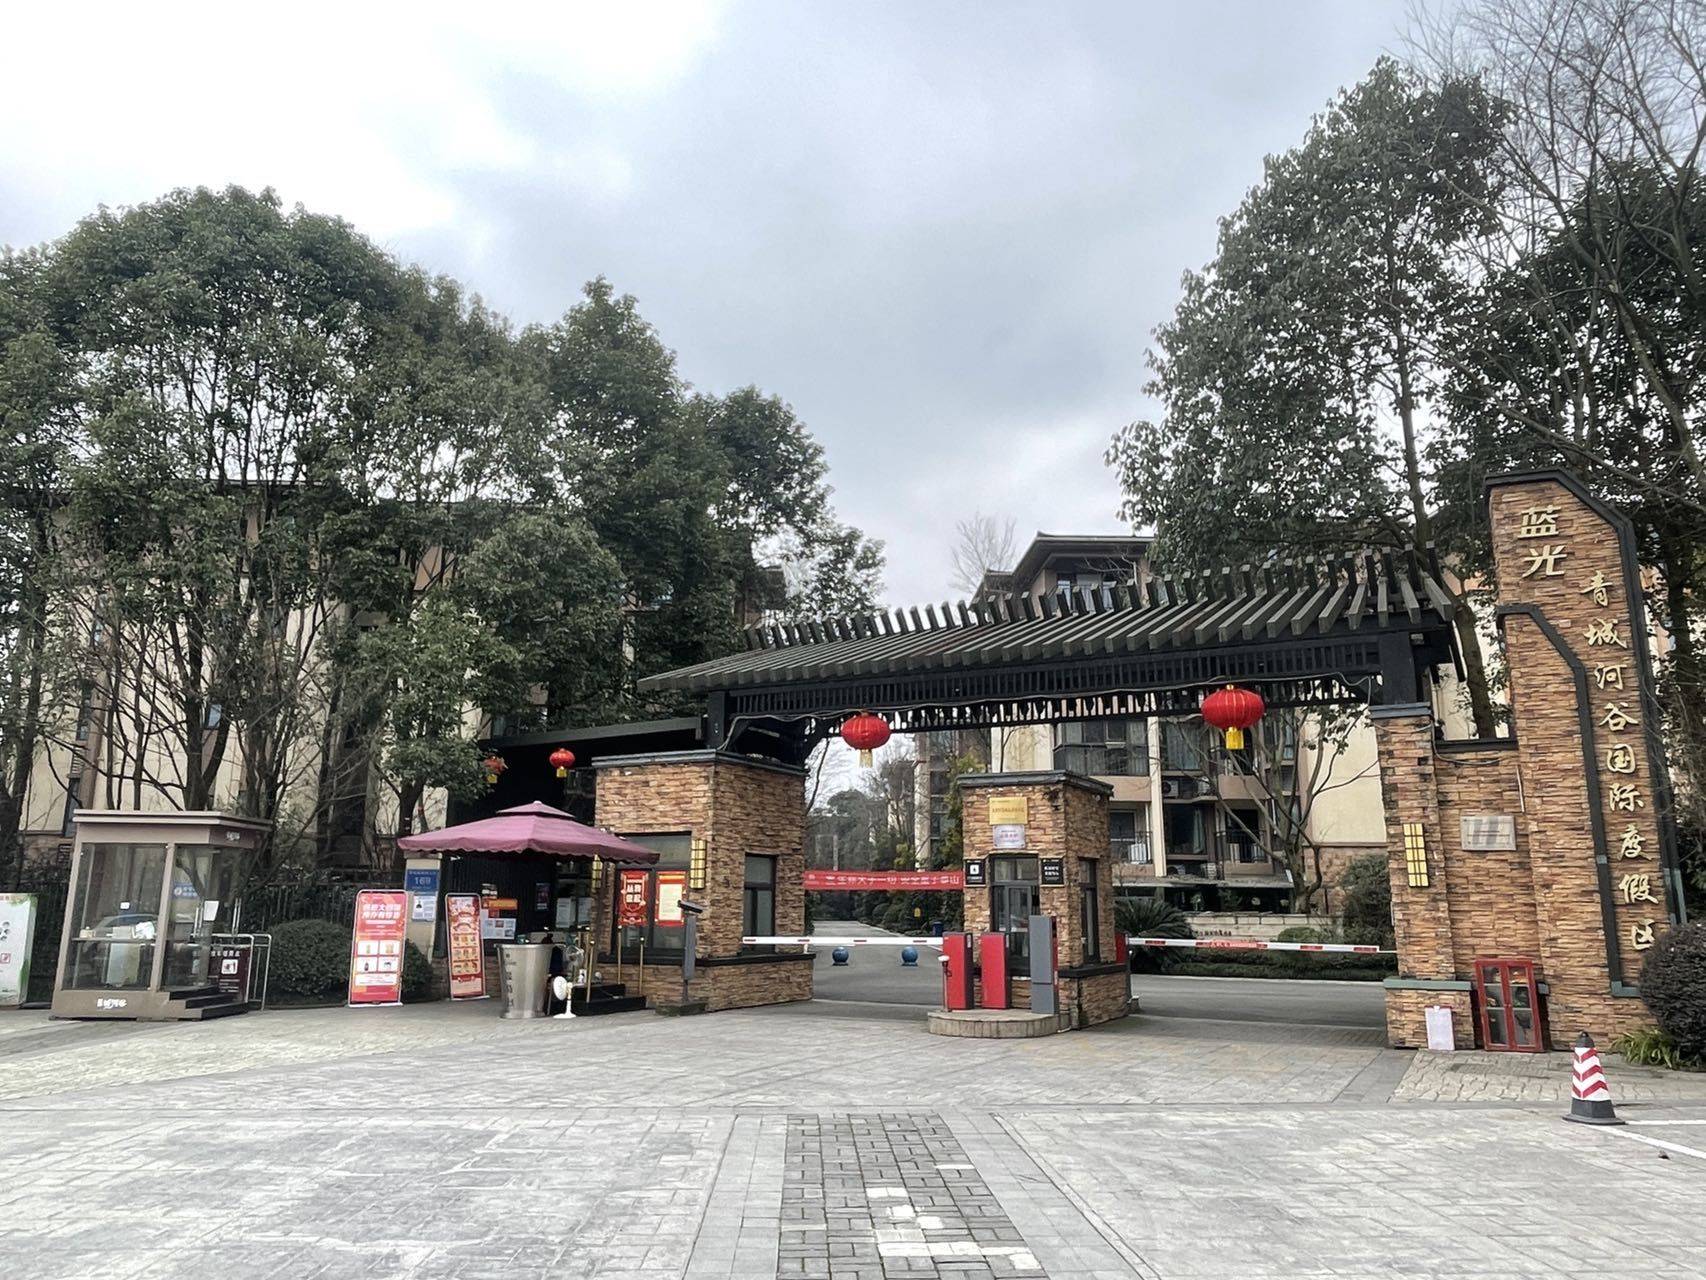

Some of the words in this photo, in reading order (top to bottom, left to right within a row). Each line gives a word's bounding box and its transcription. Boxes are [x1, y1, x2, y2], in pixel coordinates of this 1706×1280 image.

[1517, 505, 1568, 579] 蓝光
[1579, 570, 1659, 951] 青城河谷国际度假区
